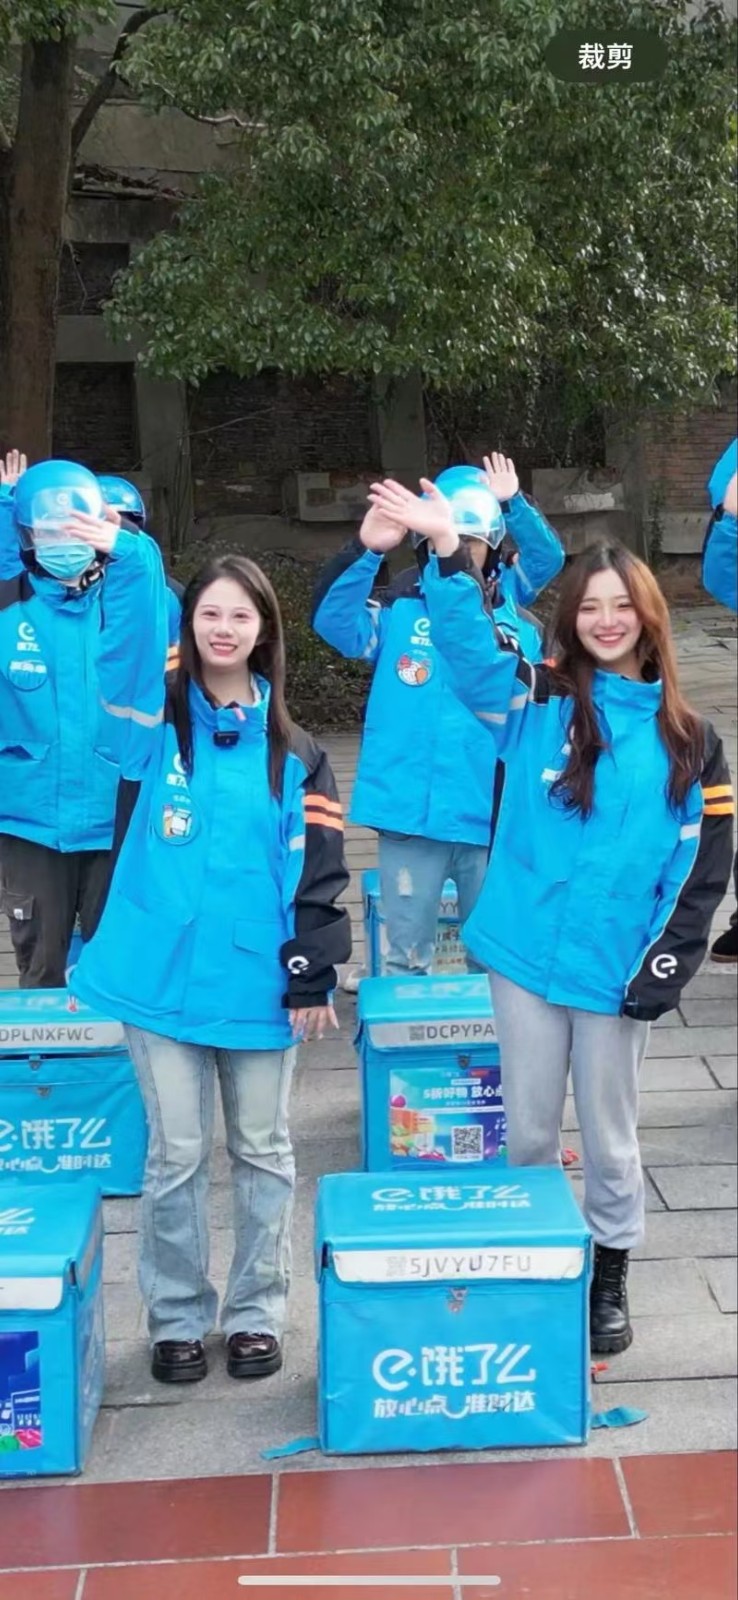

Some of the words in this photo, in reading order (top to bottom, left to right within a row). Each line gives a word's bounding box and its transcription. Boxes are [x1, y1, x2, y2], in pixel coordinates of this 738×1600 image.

[426, 1023, 495, 1040] DCPYPA
[421, 1343, 536, 1386] 饿了么
[373, 1393, 448, 1419] 放心点
[466, 1390, 536, 1414] 准时达
